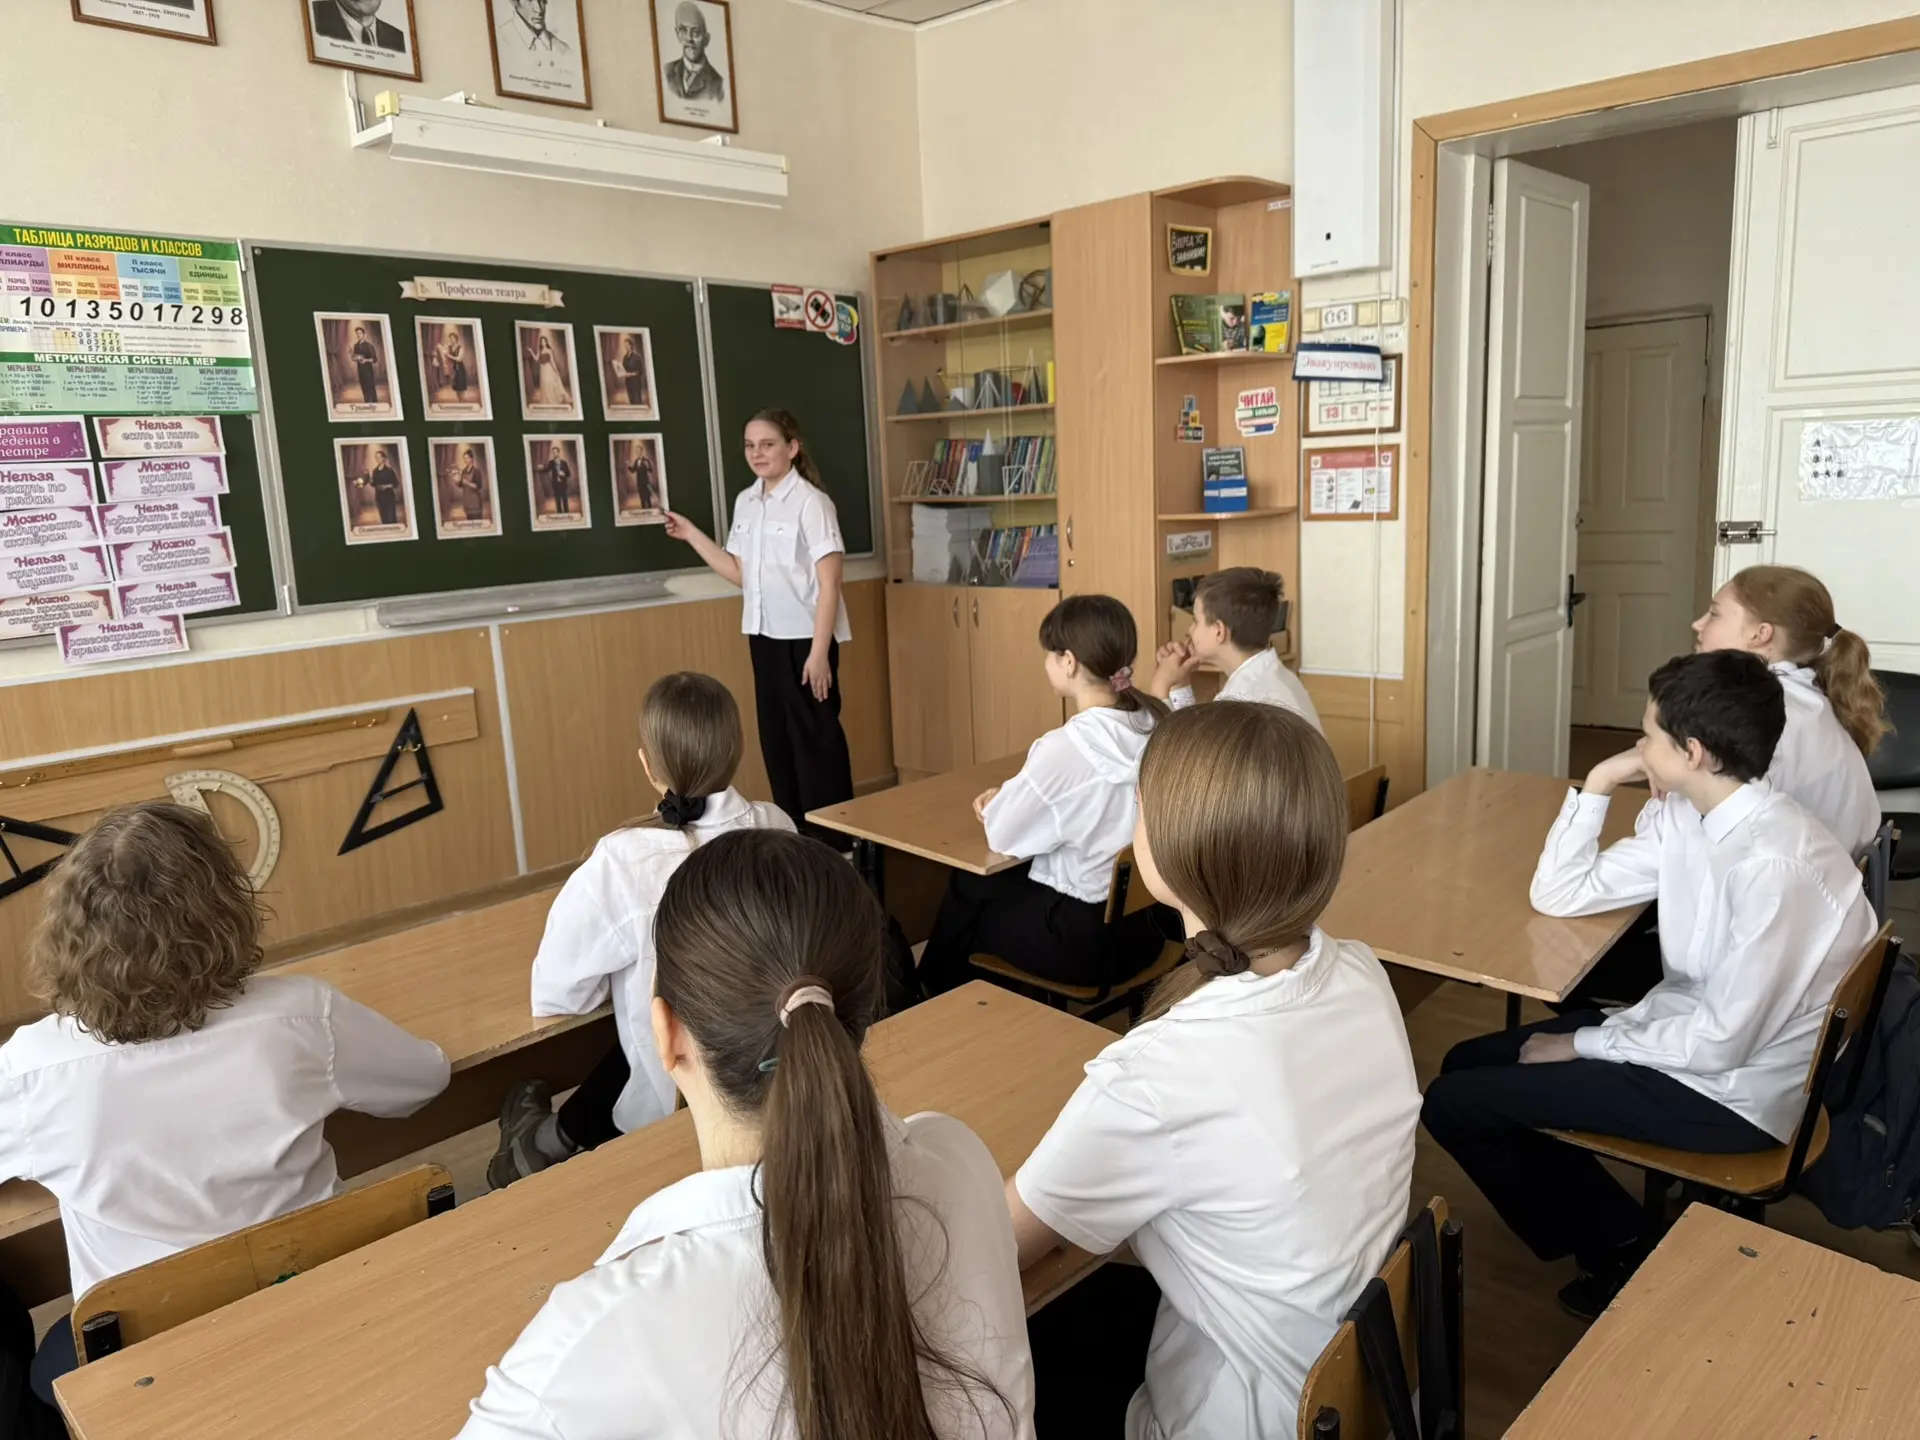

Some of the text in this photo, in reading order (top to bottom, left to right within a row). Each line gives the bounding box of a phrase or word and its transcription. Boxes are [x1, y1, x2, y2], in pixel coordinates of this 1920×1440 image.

[13, 228, 203, 257] ТАБЛИЦА РАЗРЯДОВ И КЛАССОВ
[57, 261, 110, 271] МИЛЛИОНЫ
[131, 266, 166, 275] ТЫСЯЧИ
[189, 270, 229, 280] ЕДИНИЦЫ
[436, 280, 527, 299] Профессии театра
[33, 352, 218, 366] МЕТРИЧЕСКАЯ СИСТЕМА МЕР
[1301, 355, 1377, 373] Эвакуировано
[1240, 390, 1274, 408] ЧИТАЙ
[0, 425, 49, 440] равила
[135, 419, 183, 432] Нельзя
[0, 434, 61, 447] едения в
[138, 460, 191, 474] Можно
[0, 470, 55, 483] Нельзя
[134, 502, 179, 516] Нельзя
[3, 512, 58, 528] Можно
[148, 538, 196, 552] Можно
[14, 553, 66, 569] Нельзя
[155, 581, 198, 593] Нельзя
[26, 594, 71, 607] Можно
[98, 621, 145, 634] Нельзя
